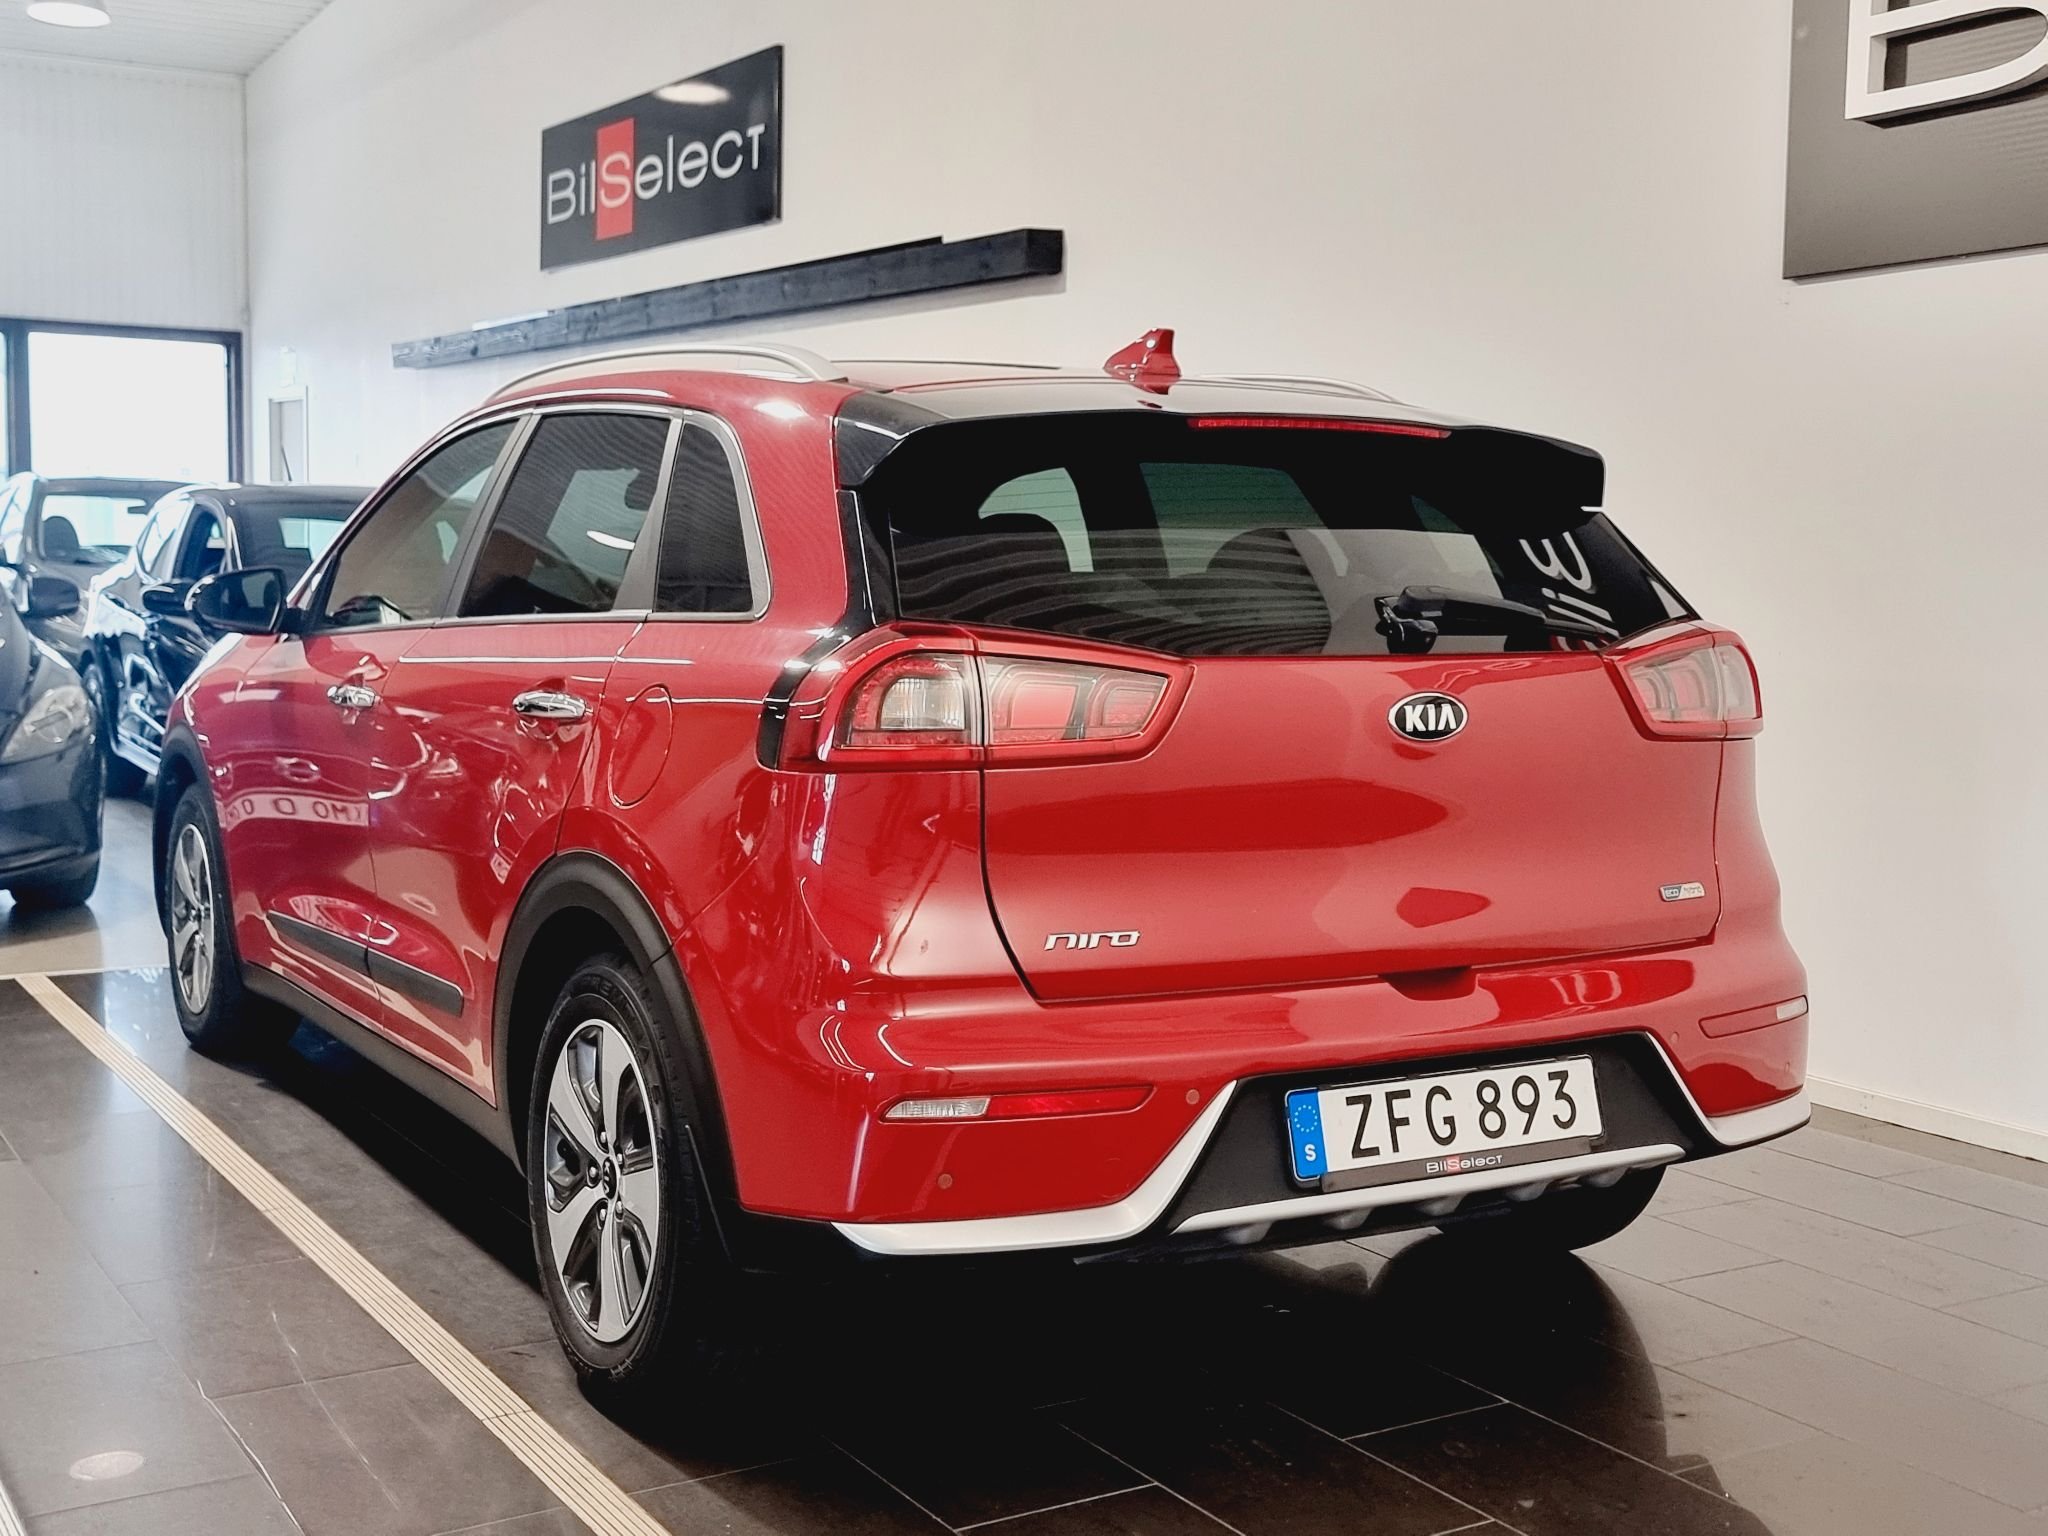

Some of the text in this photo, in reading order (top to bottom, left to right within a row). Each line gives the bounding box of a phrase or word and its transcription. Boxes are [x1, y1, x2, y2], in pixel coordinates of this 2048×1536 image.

[1403, 703, 1457, 733] KIA
[1044, 930, 1141, 951] niro
[1345, 1070, 1577, 1159] ZFG 893
[1304, 1144, 1317, 1162] S
